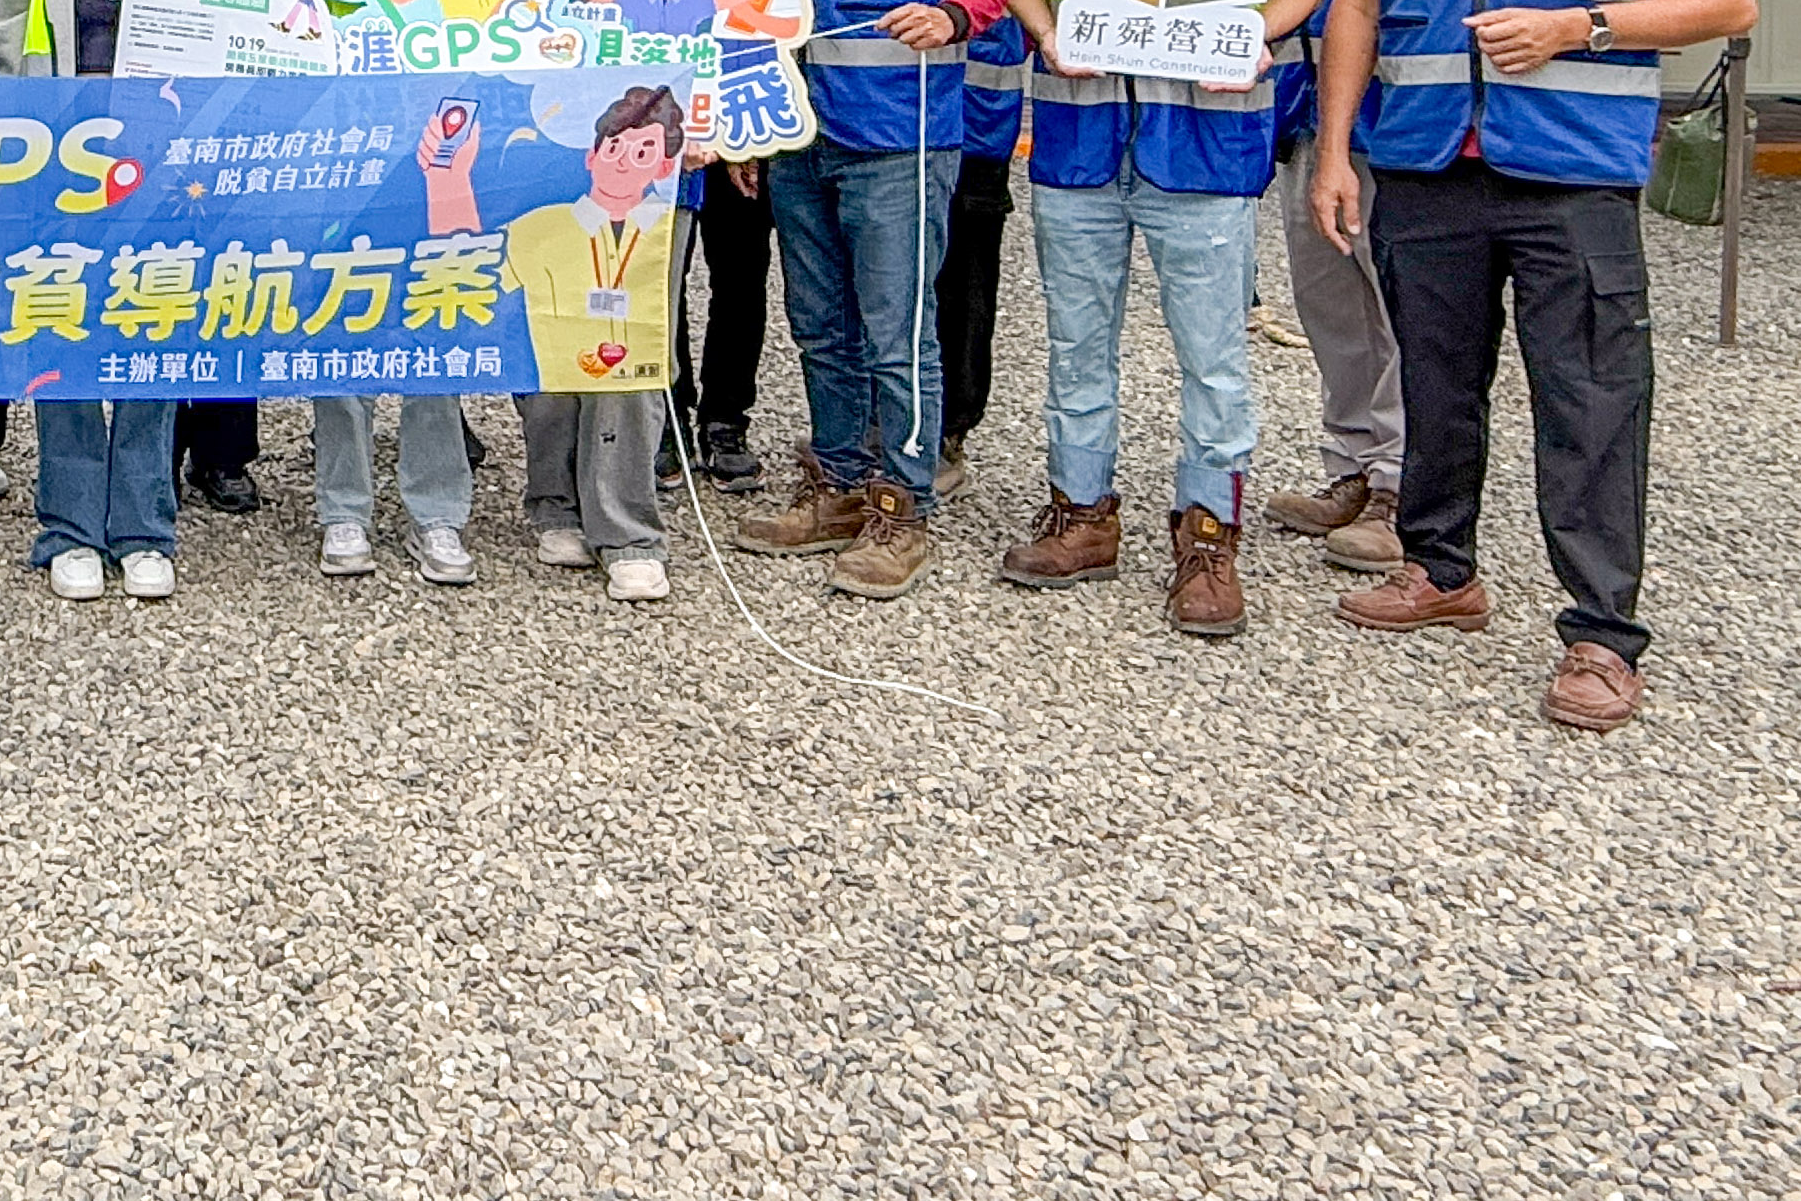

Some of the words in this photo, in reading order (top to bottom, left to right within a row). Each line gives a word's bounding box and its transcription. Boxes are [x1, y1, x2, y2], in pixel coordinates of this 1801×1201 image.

[228, 34, 246, 49] 10
[336, 19, 522, 73] 涯GPS
[1069, 10, 1254, 59] 新舜營造
[1069, 51, 1101, 64] Hsin
[1107, 53, 1145, 69] Shun
[1149, 57, 1247, 78] Construction
[164, 124, 393, 166] 臺南市政府社會局
[213, 159, 386, 197] 脫貧自立計畫
[98, 350, 219, 384] 主辦單位
[260, 345, 502, 381] 臺南市政府社會局
